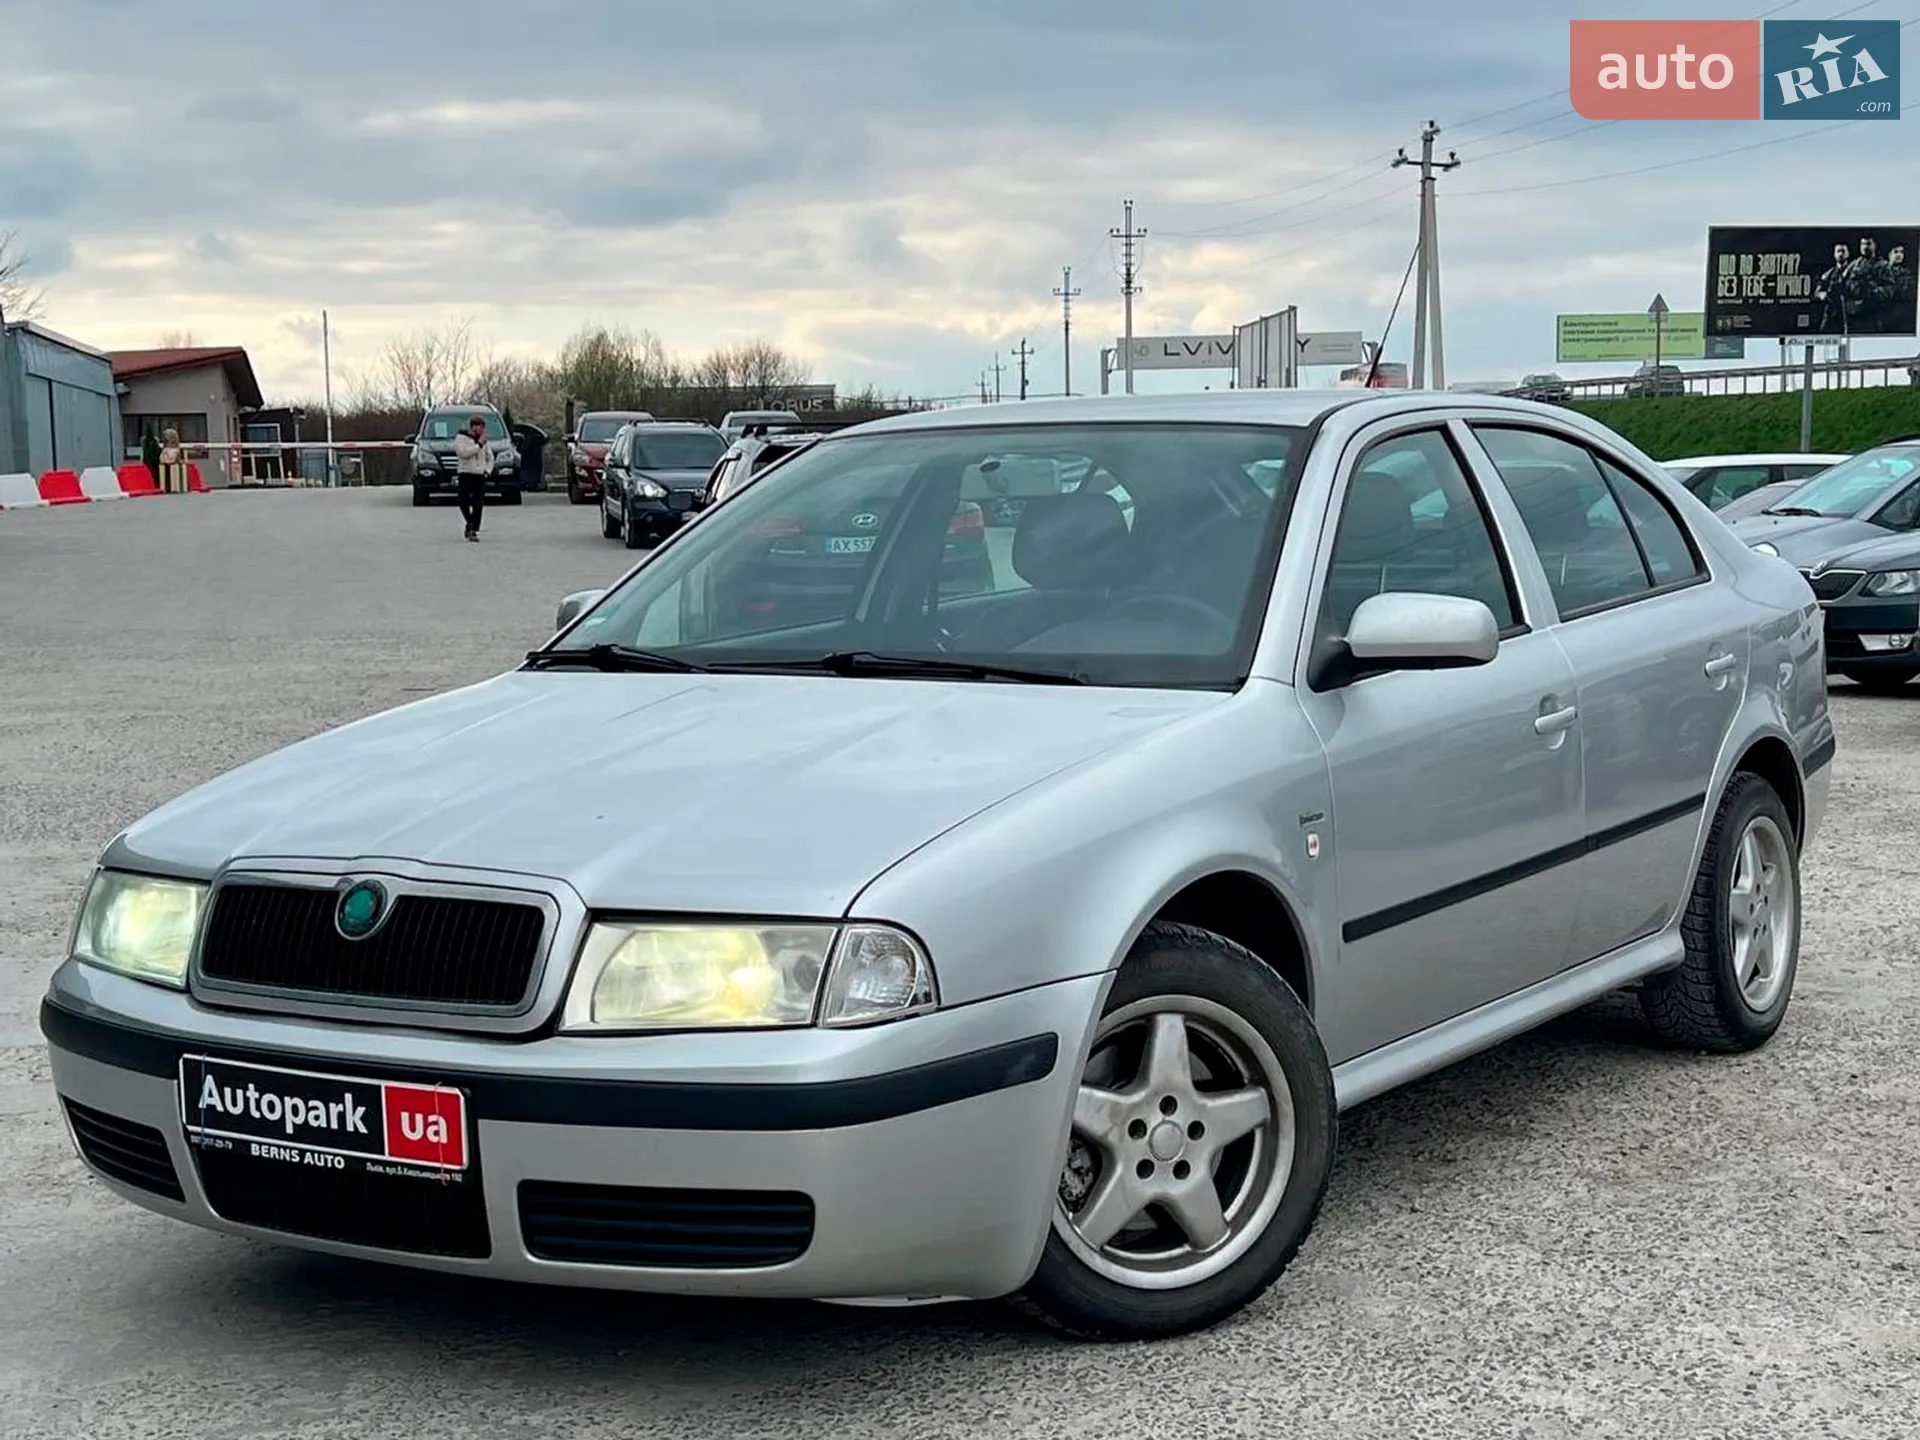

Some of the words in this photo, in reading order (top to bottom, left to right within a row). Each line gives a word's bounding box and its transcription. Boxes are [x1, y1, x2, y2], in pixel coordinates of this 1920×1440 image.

[1717, 275, 1738, 297] БЕЗ
[199, 1074, 369, 1135] Autopark
[400, 1110, 449, 1144] ua
[250, 1142, 300, 1163] BERNS
[303, 1151, 345, 1170] AUTO
